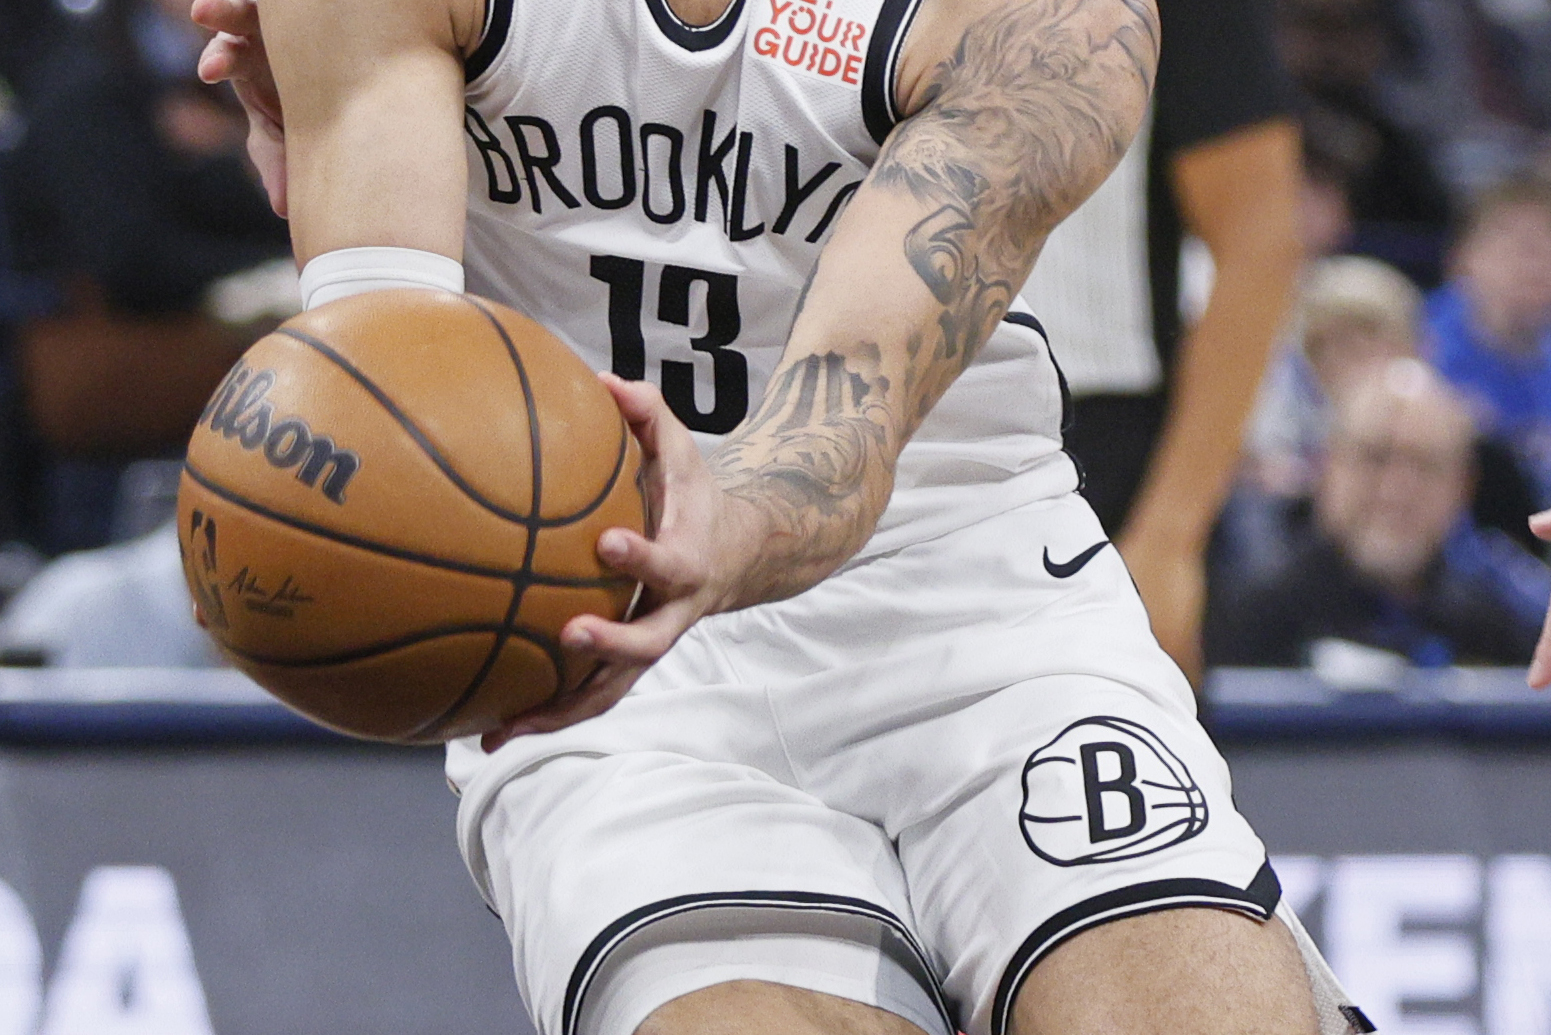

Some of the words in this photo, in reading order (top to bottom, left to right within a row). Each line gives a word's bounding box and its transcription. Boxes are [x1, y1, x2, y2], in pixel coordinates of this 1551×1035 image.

[754, 27, 863, 85] GUIDE
[590, 254, 749, 435] 13
[1080, 741, 1146, 844] B
